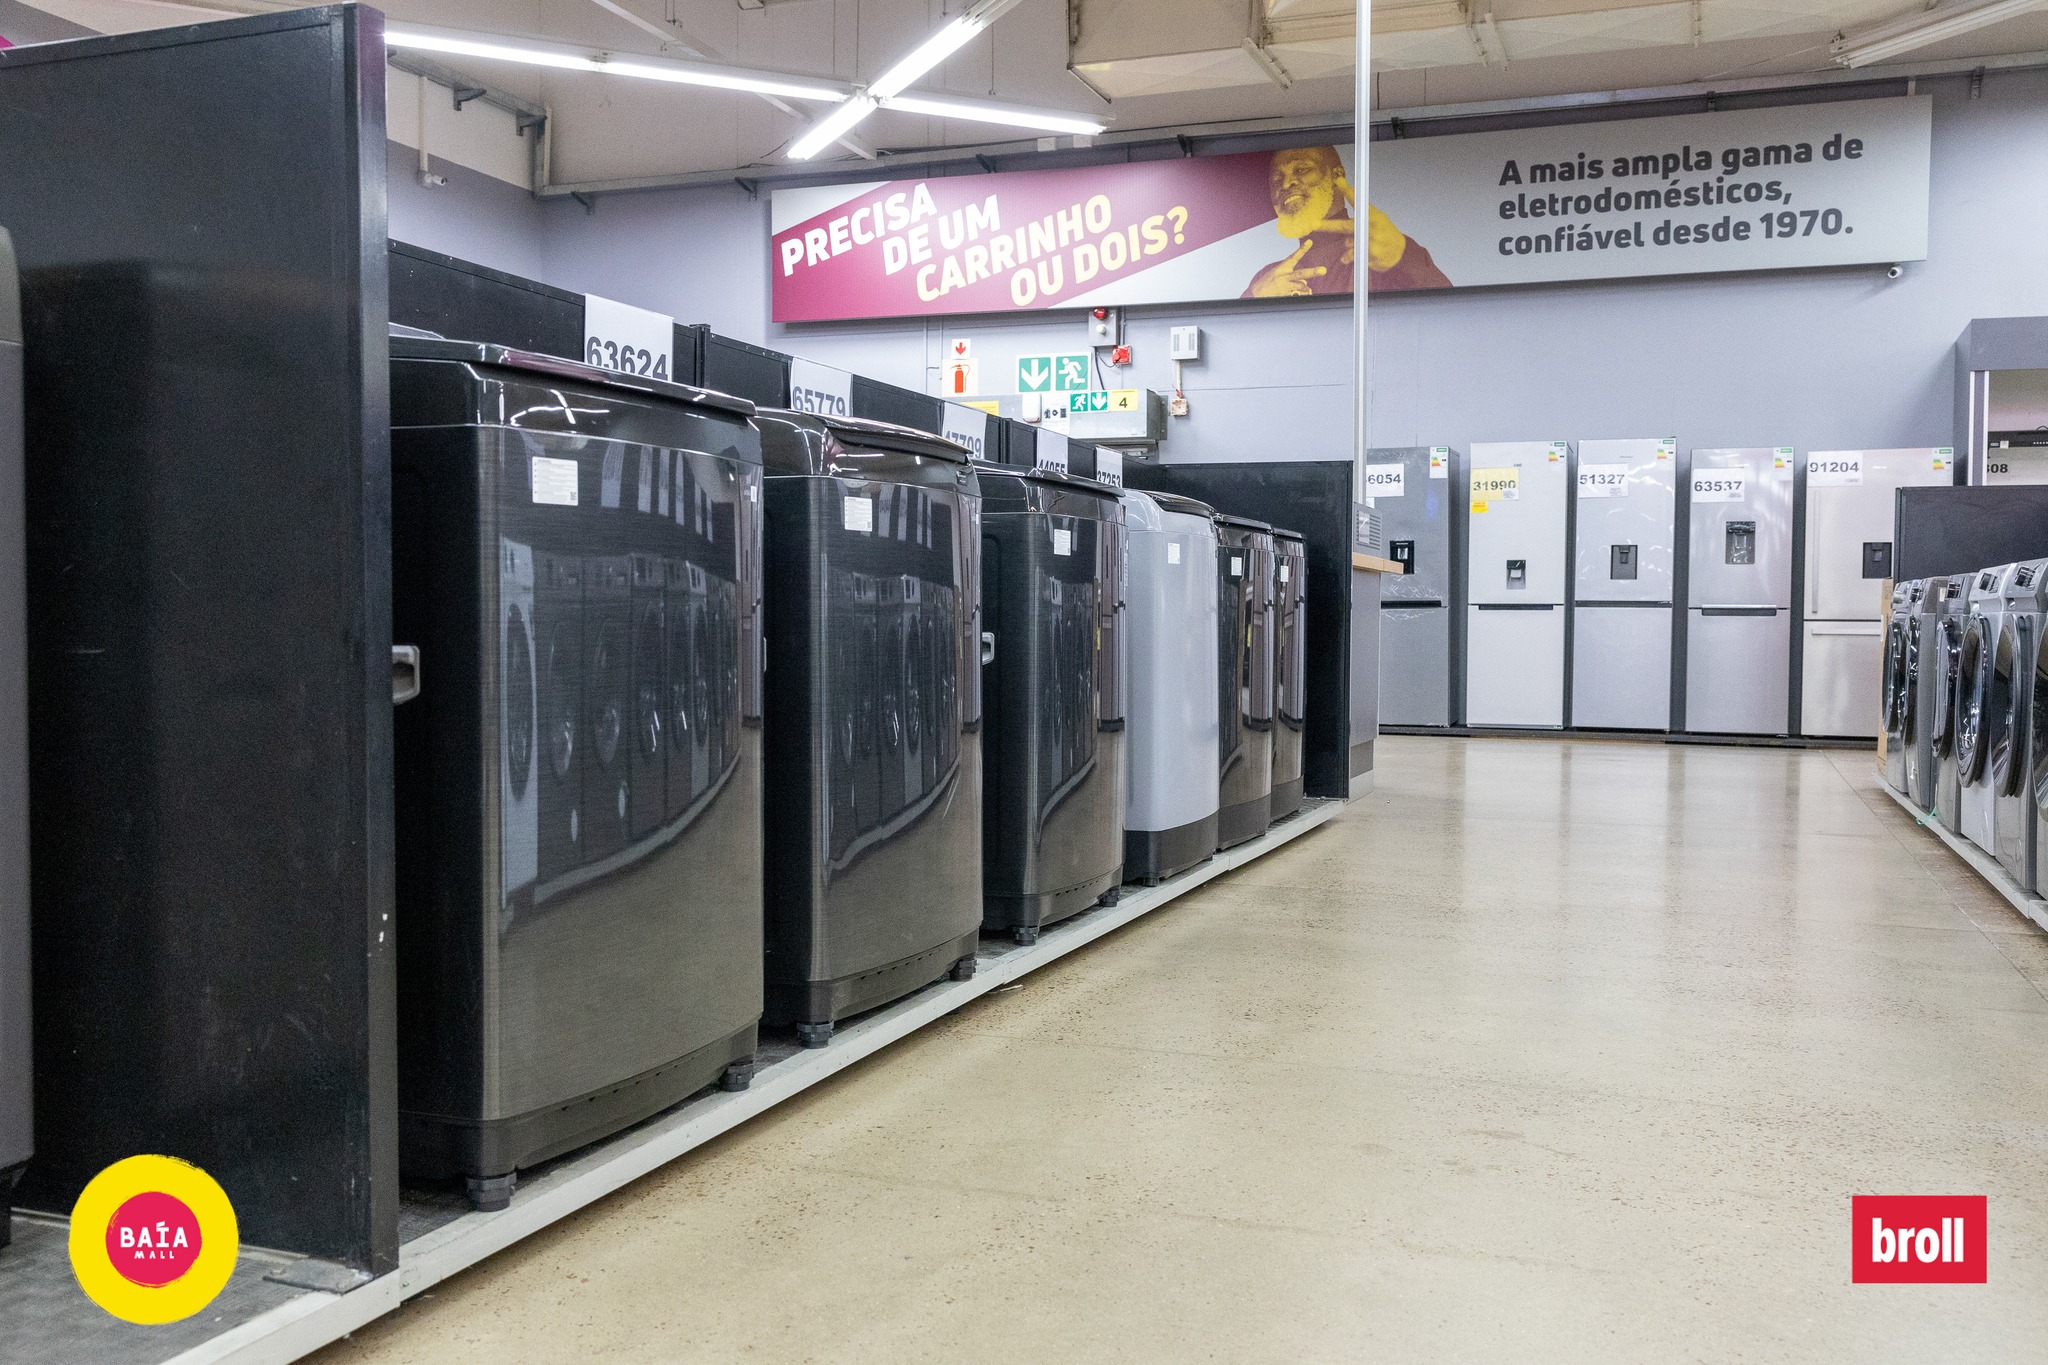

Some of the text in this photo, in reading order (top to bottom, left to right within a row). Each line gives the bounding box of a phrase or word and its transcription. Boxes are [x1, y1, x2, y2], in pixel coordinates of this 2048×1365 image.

[1498, 133, 1864, 186] A mais ampla gama de
[1498, 176, 1793, 220] eletrodomésticos,
[781, 182, 937, 277] PRECISA
[882, 194, 1001, 276] DE UM
[916, 194, 1112, 302] CARRINHO
[1498, 207, 1854, 256] confiável desde 1970.
[1010, 205, 1189, 307] OU DOIS?
[587, 336, 668, 381] 63624
[793, 386, 845, 416] 65779
[1119, 397, 1128, 408] 4
[1366, 474, 1401, 484] 6054
[1579, 474, 1625, 485] 51327
[1809, 462, 1859, 473] 91204
